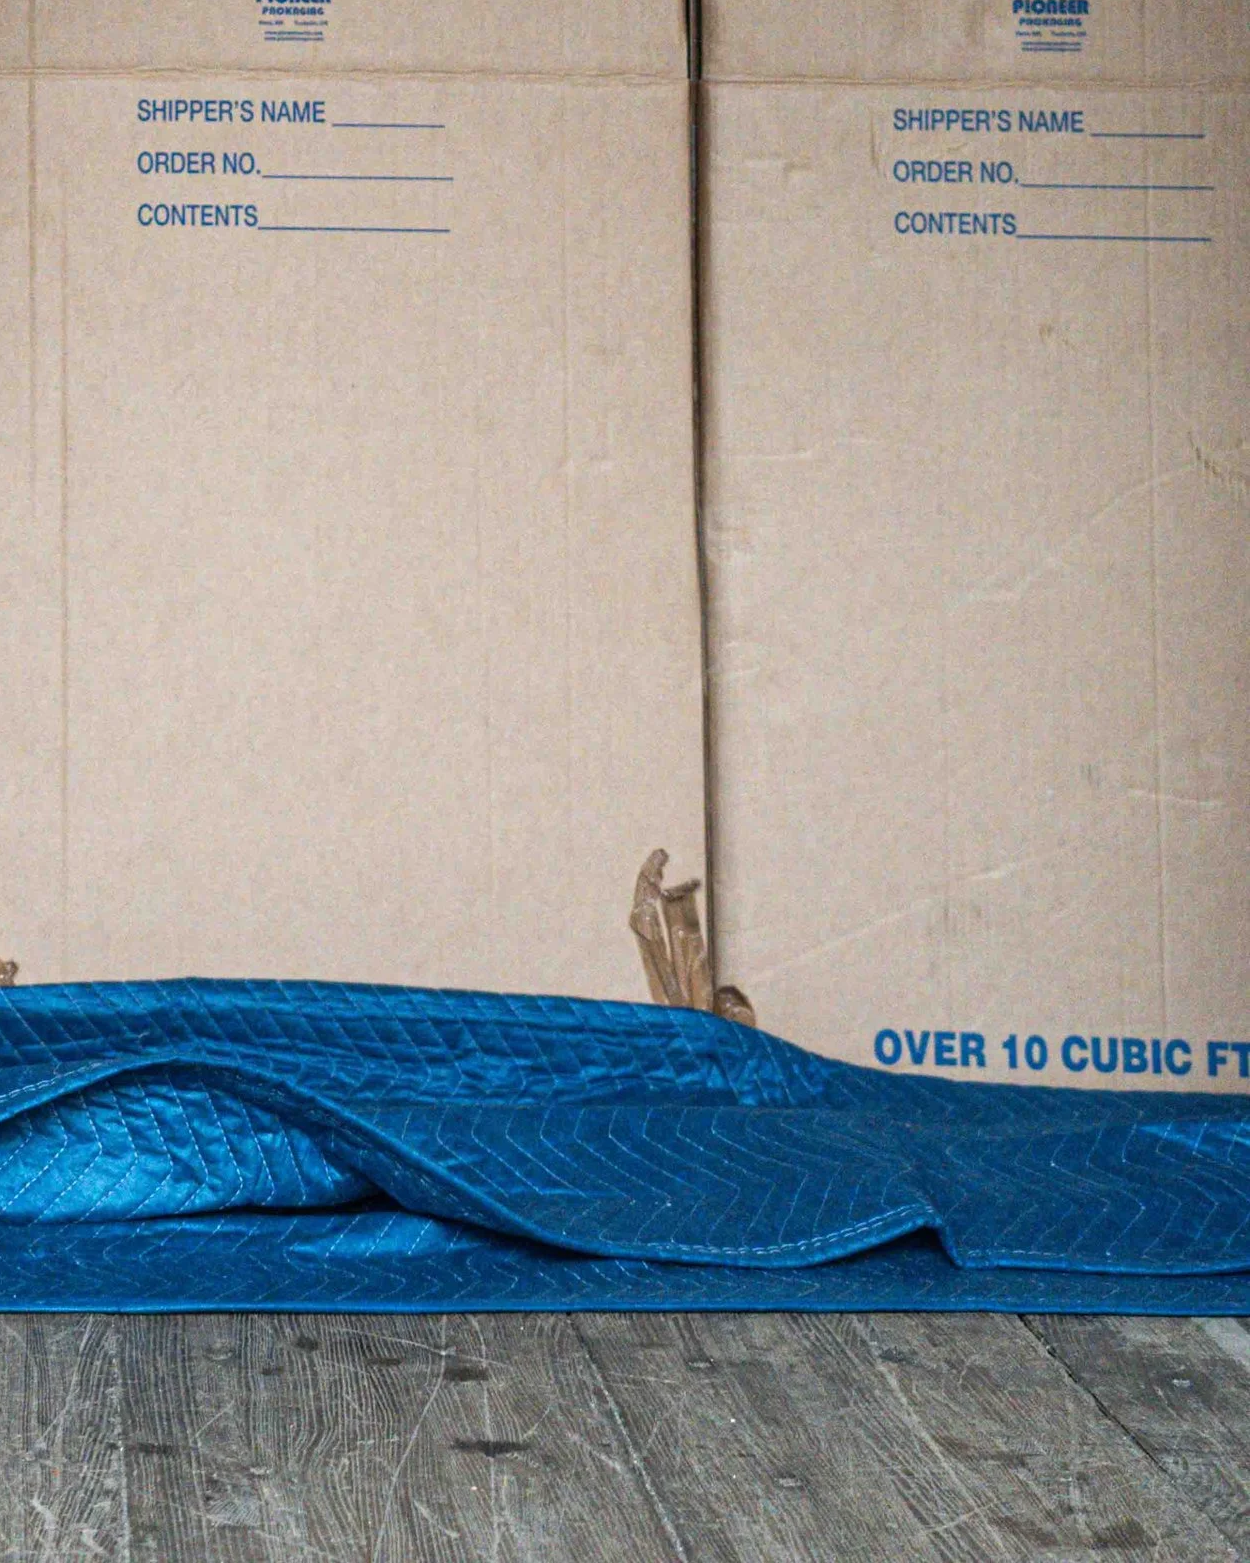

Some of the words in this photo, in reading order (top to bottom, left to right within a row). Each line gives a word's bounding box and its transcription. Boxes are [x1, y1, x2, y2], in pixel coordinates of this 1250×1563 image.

[1012, 0, 1089, 15] PIONEER
[137, 99, 255, 125] SHIPPER'S
[261, 101, 326, 124] NAME
[893, 109, 1012, 134] SHIPPER'S
[1019, 111, 1085, 135] NAME
[137, 152, 216, 176] ORDER
[223, 152, 261, 177] NO.
[893, 161, 973, 185] ORDER
[980, 162, 1019, 185] NO.
[137, 204, 259, 228] CONTENTS
[894, 213, 1017, 237] CONTENTS
[873, 1028, 986, 1068] OVER
[1001, 1034, 1049, 1071] 10
[1061, 1035, 1193, 1077] CUBIC
